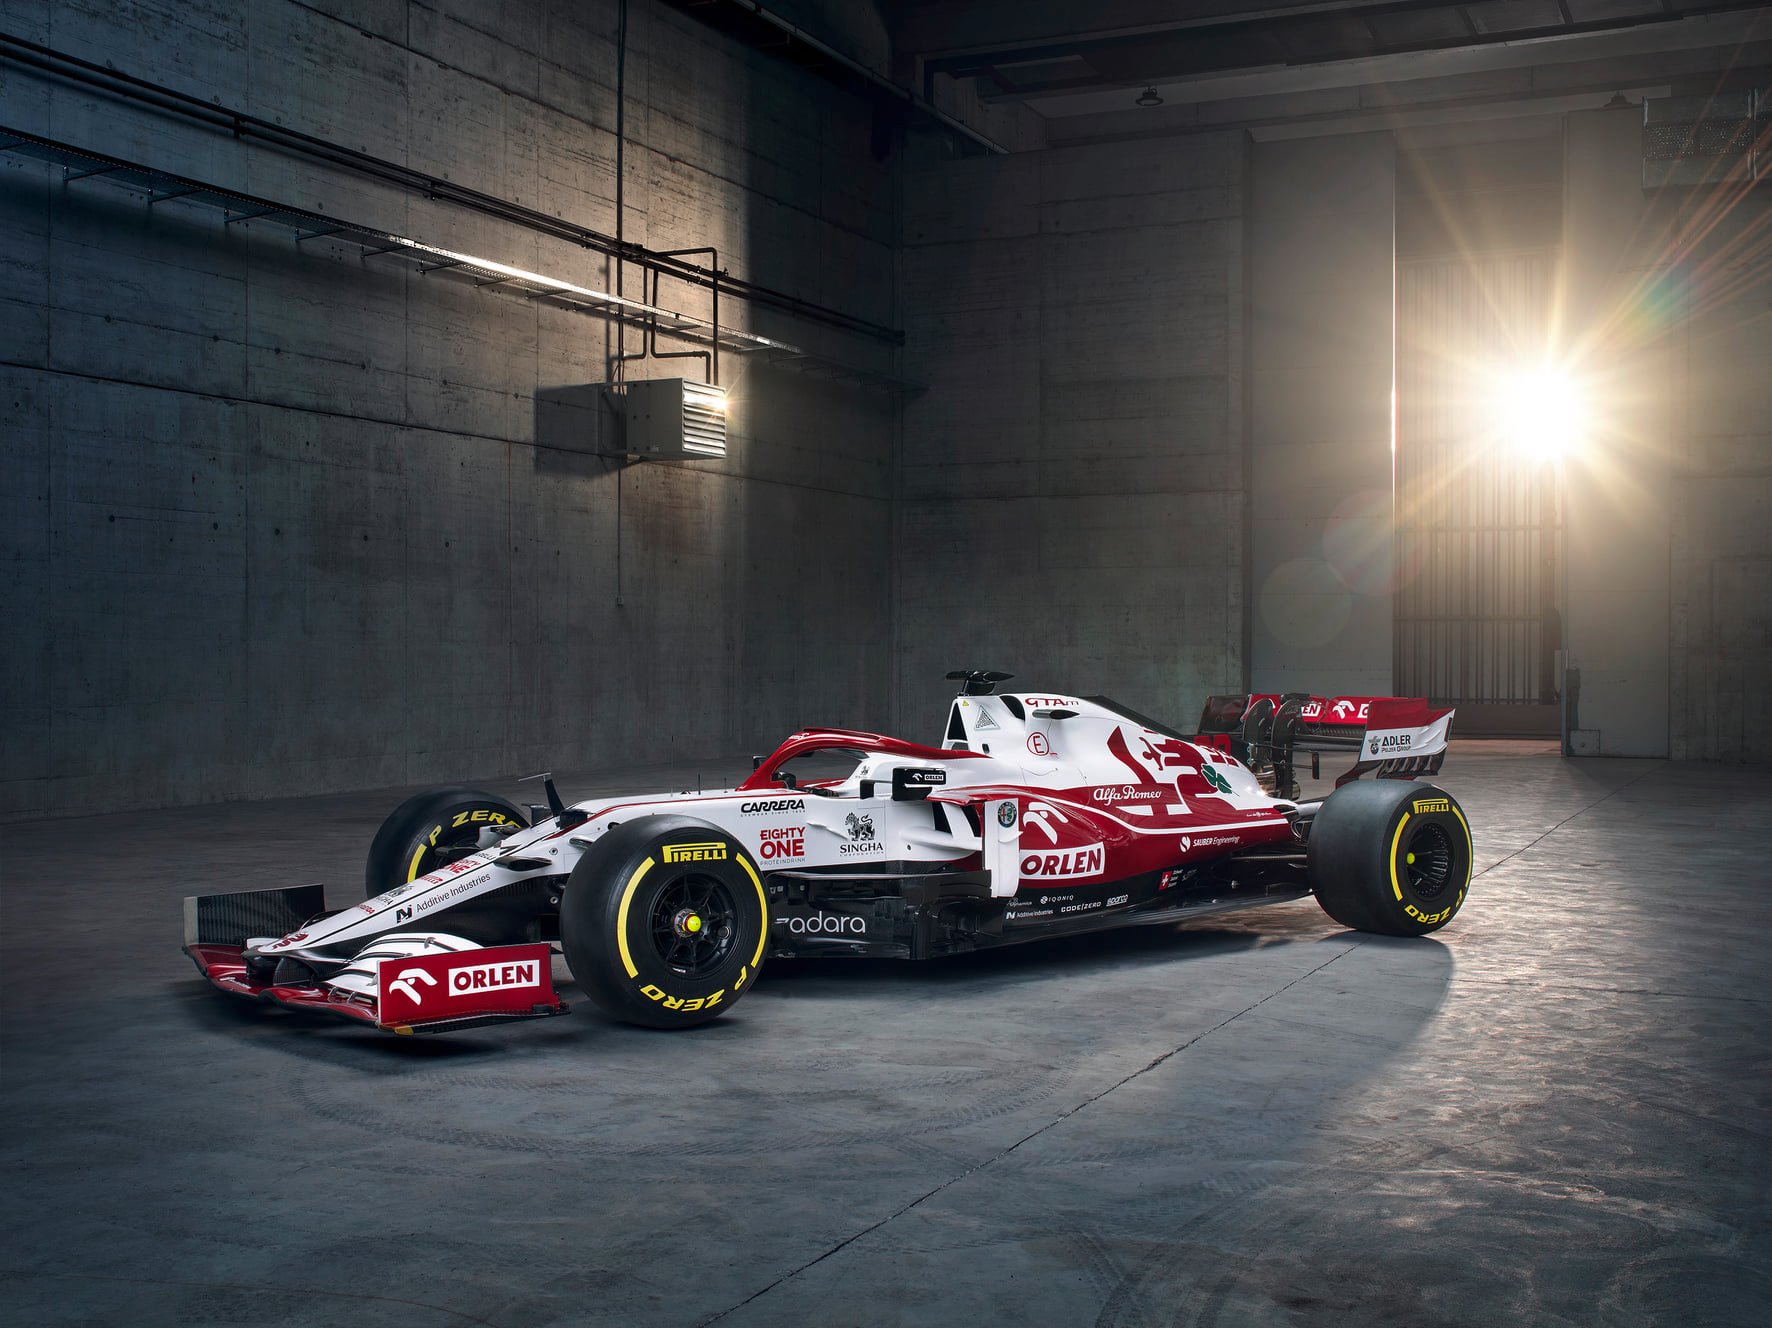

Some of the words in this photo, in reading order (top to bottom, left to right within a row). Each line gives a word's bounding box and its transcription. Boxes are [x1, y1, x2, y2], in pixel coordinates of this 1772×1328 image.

[1381, 734, 1411, 747] ADLER
[740, 798, 806, 814] CARRERA
[1093, 787, 1123, 806] Alfa
[1122, 785, 1162, 799] Romeo
[1412, 798, 1449, 814] PIRELLI
[429, 824, 442, 847] P
[759, 826, 806, 841] EIGHTY
[1192, 837, 1213, 847] SAUBER
[1212, 835, 1241, 846] Engineering
[662, 842, 727, 863] PIRELLI
[759, 838, 805, 859] ONE
[839, 842, 884, 854] SINGHA
[1020, 847, 1102, 876] ORLEN
[416, 892, 450, 913] Additive
[450, 873, 491, 897] Industries
[1404, 904, 1451, 925] ZERO
[453, 964, 534, 991] ORLEN
[734, 965, 747, 991] P
[640, 984, 725, 1012] ZERO
